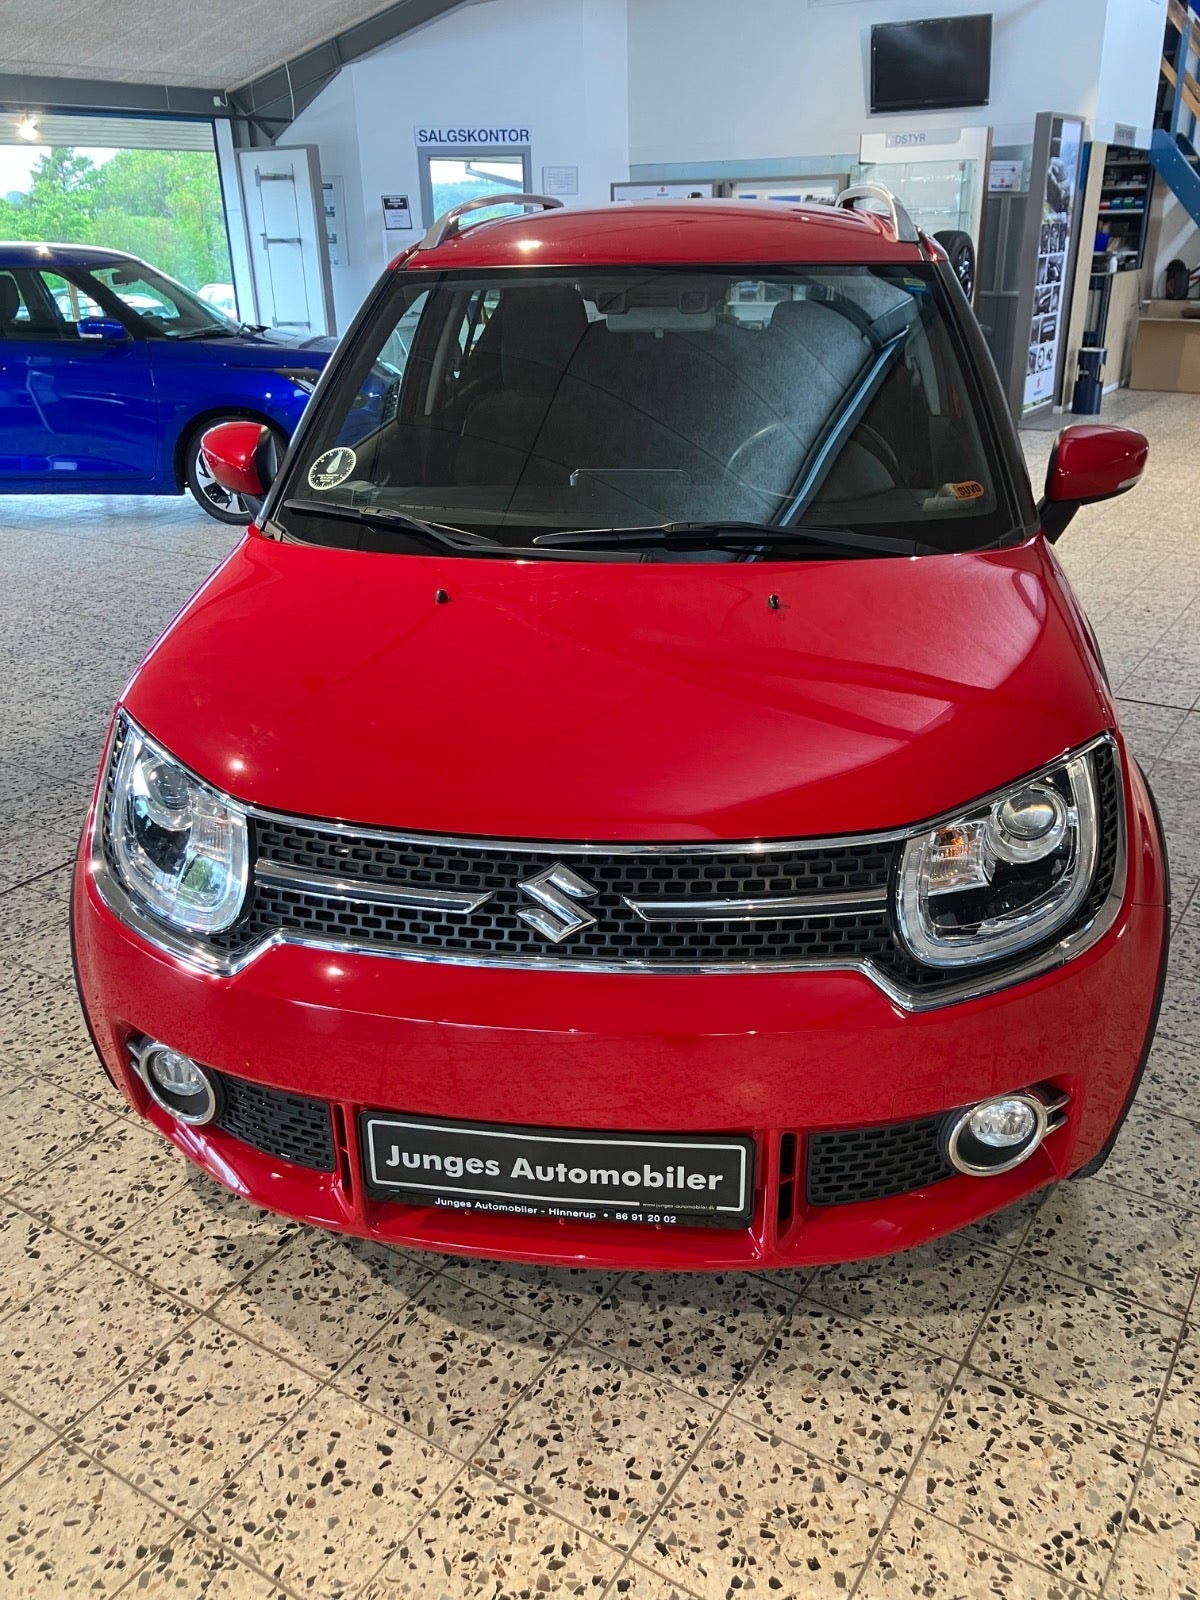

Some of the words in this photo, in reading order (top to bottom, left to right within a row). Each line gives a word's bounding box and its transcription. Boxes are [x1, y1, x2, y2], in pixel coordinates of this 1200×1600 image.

[418, 129, 529, 143] SALGSKONTOR
[385, 1145, 500, 1178] Junges
[510, 1157, 723, 1190] Automobiler
[434, 1197, 472, 1208] Junges
[474, 1201, 538, 1214] Automobiler
[548, 1207, 597, 1219] Hinnerup
[615, 1212, 628, 1220] 86
[631, 1213, 643, 1221] 91
[647, 1214, 661, 1222] 20
[663, 1215, 677, 1223] 02
